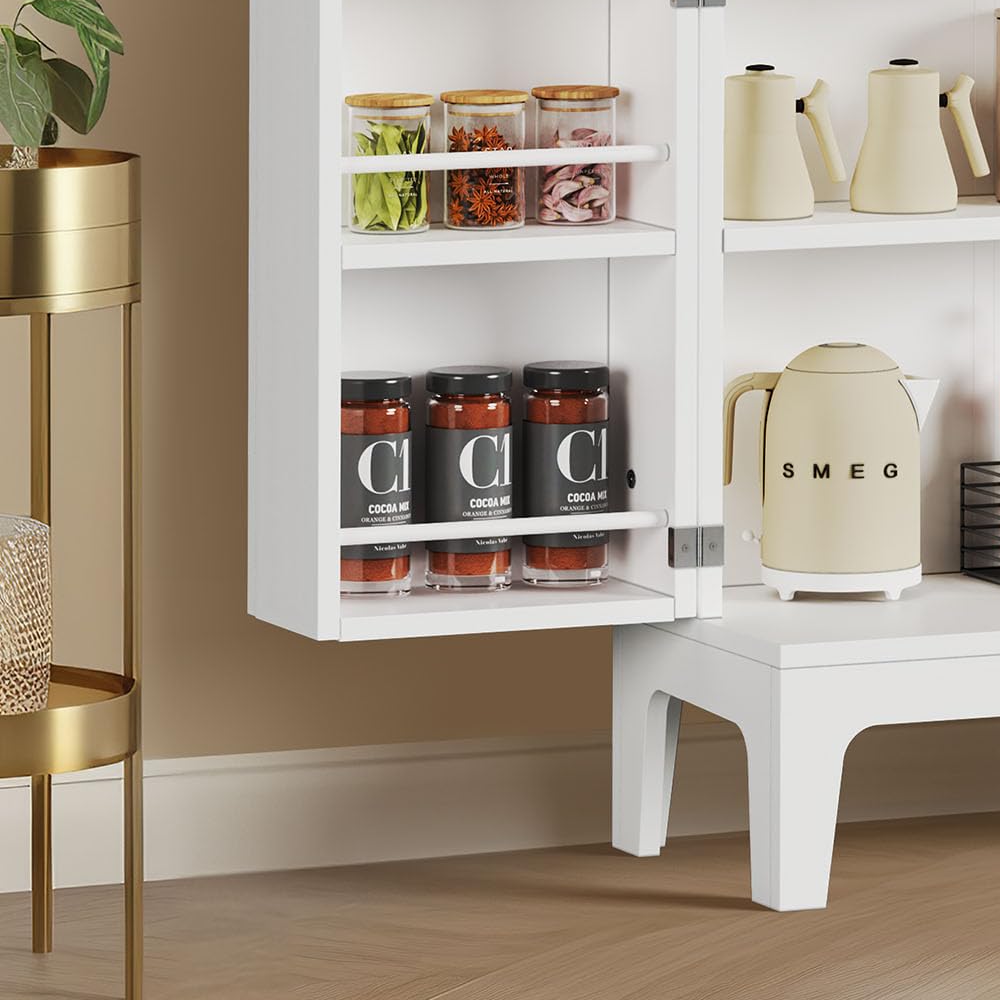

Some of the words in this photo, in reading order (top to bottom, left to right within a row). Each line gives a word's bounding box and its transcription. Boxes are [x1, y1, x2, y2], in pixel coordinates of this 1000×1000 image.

[470, 497, 499, 508] COCOA
[500, 495, 511, 507] MIX
[567, 491, 596, 503] COCOA
[597, 489, 607, 501] MIX
[368, 502, 398, 514] COCOA
[399, 501, 410, 512] MIX
